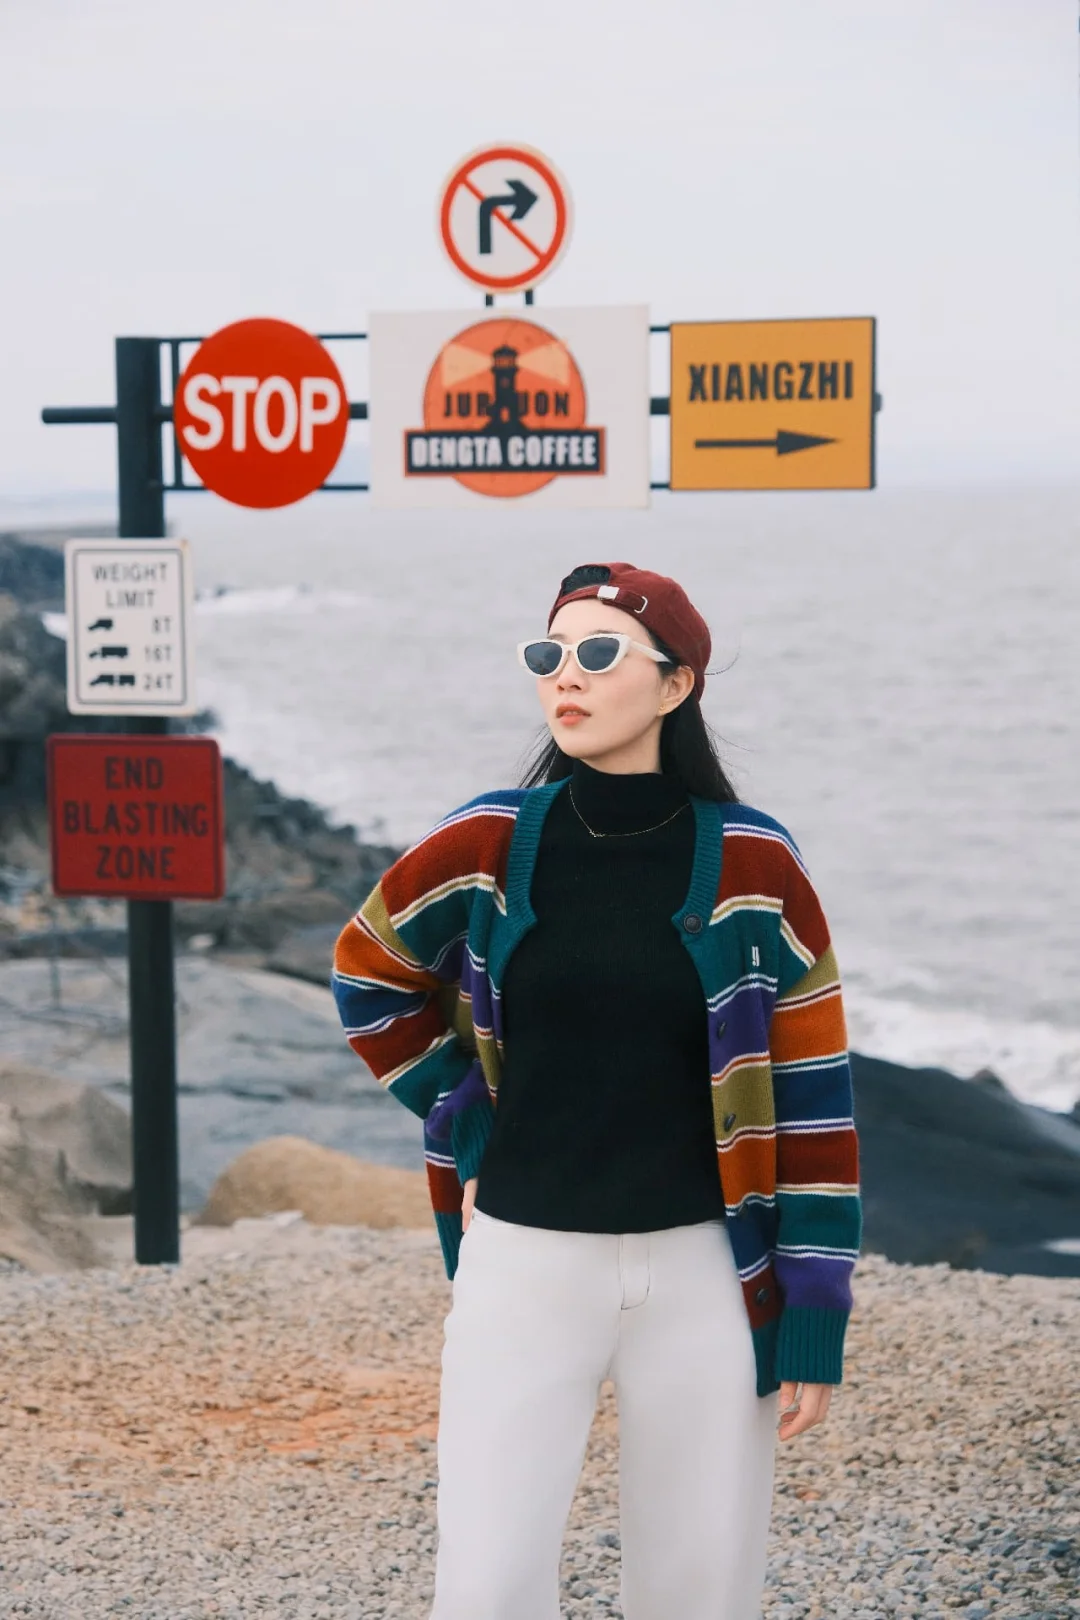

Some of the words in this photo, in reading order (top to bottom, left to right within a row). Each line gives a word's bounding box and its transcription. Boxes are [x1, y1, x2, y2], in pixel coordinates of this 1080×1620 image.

[688, 360, 854, 402] XIANGZHI
[182, 373, 341, 453] STOP
[411, 436, 503, 467] DENGTA
[507, 435, 597, 466] COFFEE
[93, 562, 168, 582] WEIGHT
[106, 589, 155, 608] LIMIT
[105, 755, 164, 790] END
[63, 800, 209, 837] BLASTING
[95, 844, 176, 880] ZONE
